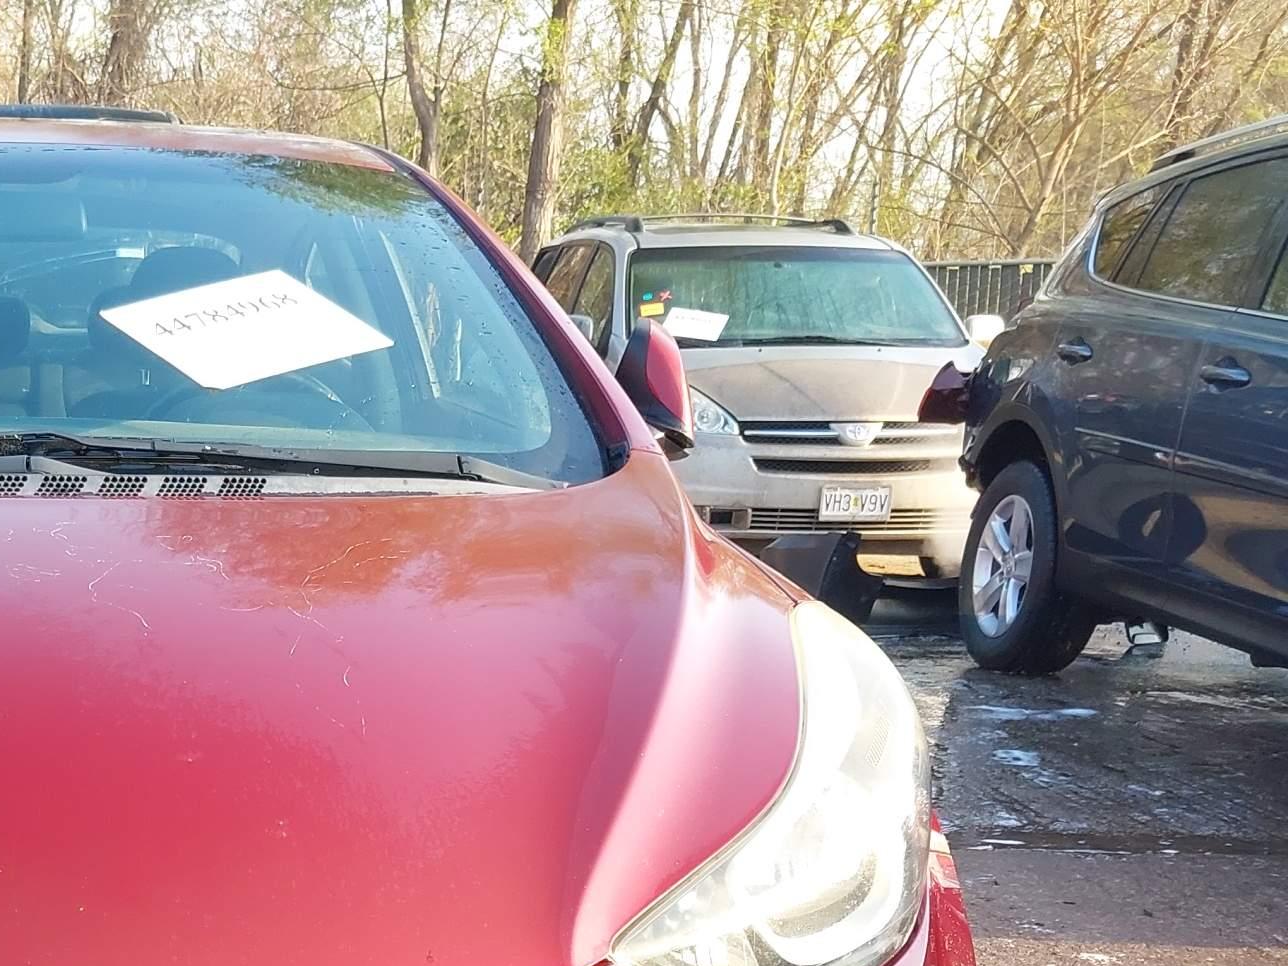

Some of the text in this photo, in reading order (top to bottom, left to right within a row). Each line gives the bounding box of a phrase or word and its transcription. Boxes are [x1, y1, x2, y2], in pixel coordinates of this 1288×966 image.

[155, 293, 298, 336] 44784968
[824, 493, 889, 513] VH3 V9V
